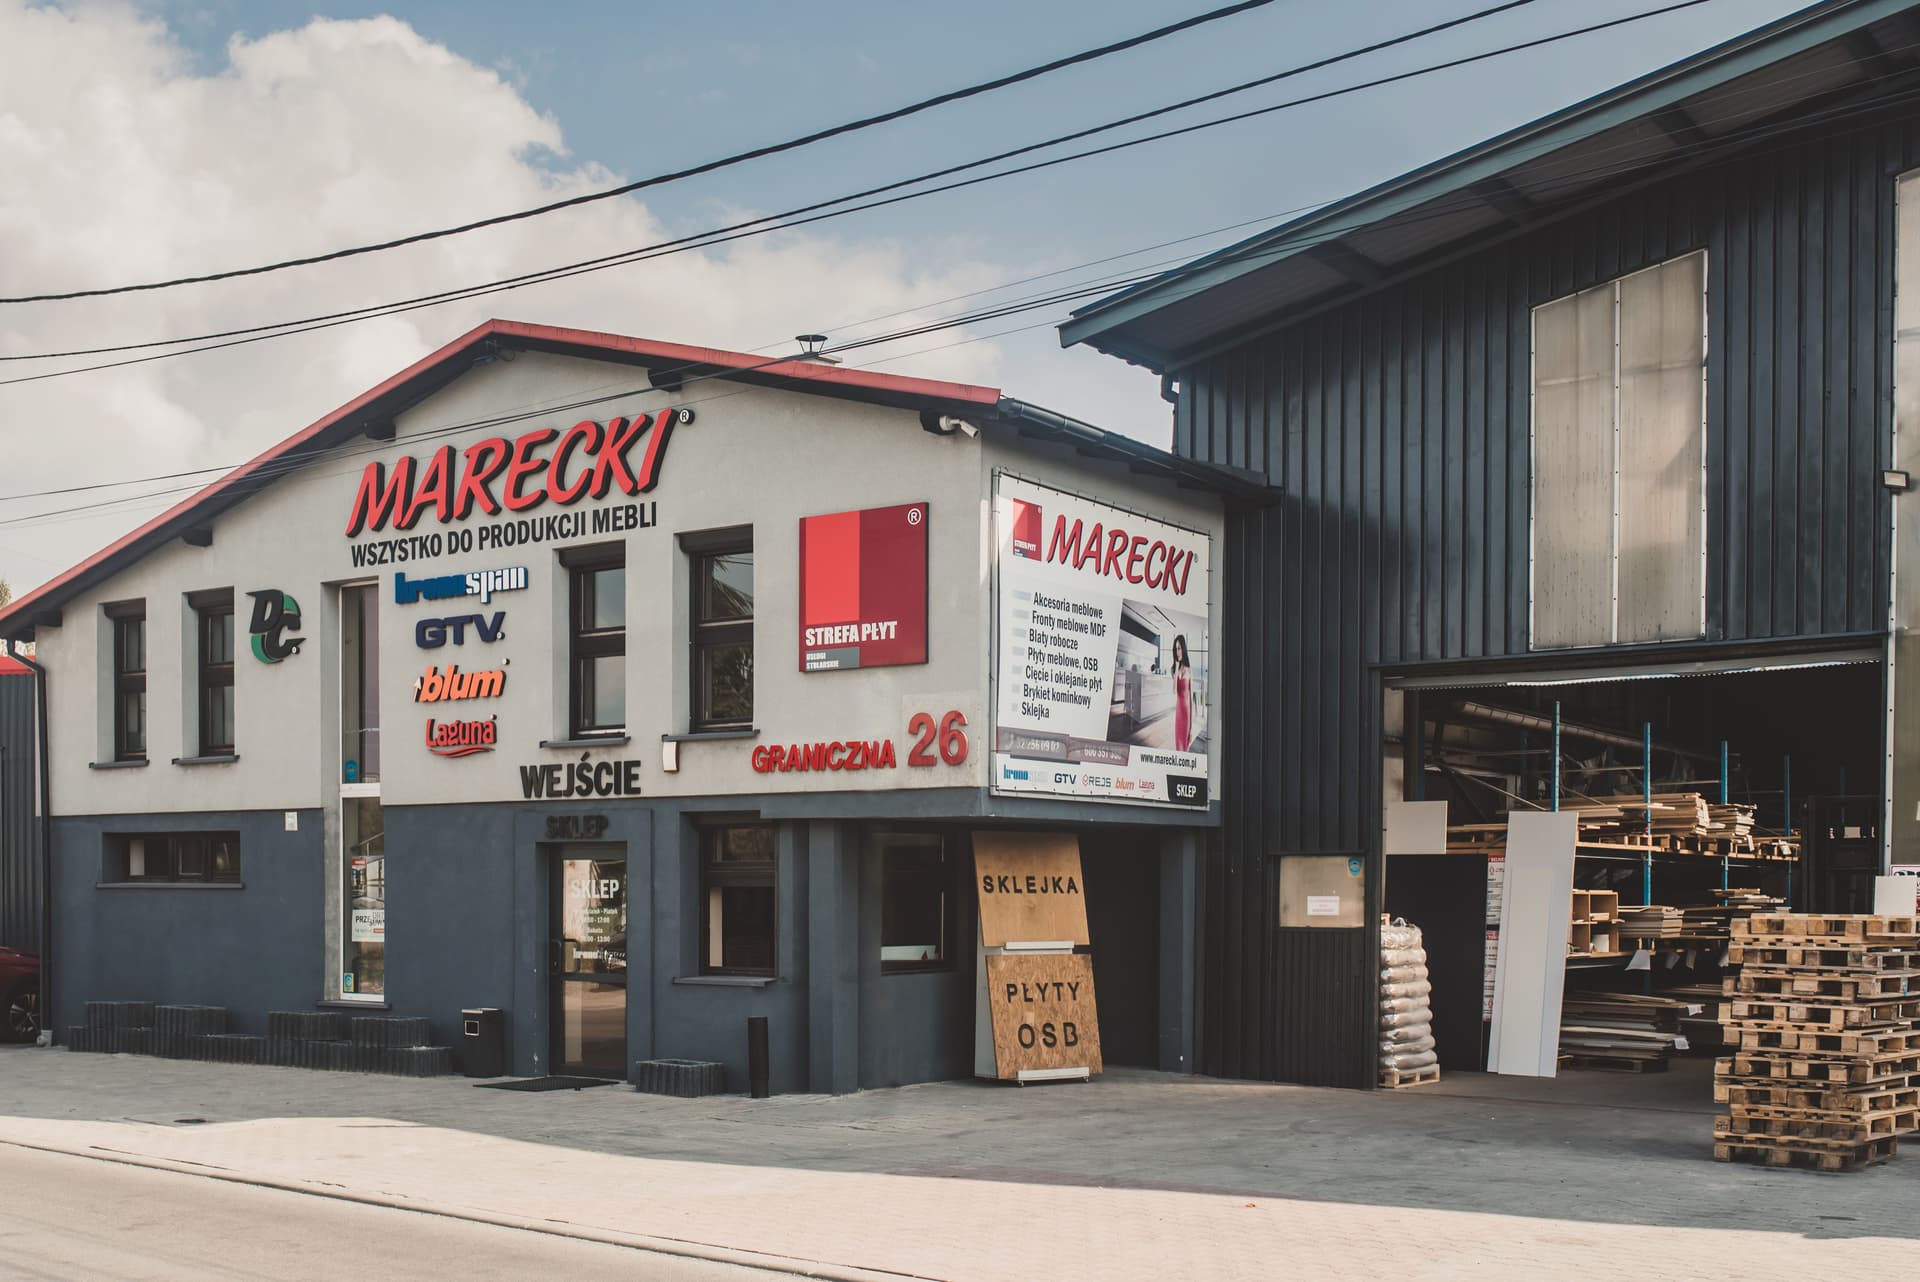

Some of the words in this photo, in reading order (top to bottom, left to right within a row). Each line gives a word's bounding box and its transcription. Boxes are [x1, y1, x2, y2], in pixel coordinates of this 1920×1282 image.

[346, 408, 678, 538] MARECKI
[351, 536, 442, 568] WSZYSTKO
[447, 529, 473, 556] DO
[478, 510, 586, 550] PRODUKCJI
[592, 502, 657, 534] MEBLI
[1047, 514, 1193, 596] MARECKI
[1033, 592, 1071, 614] Akcesoria
[1072, 603, 1103, 620] meblowe
[416, 611, 506, 649] GTV
[805, 624, 859, 646] STREFA
[861, 620, 897, 642] PŁYT
[1032, 610, 1055, 631] Fronty
[1056, 618, 1088, 634] meblowe
[1090, 622, 1106, 638] MDF
[1029, 628, 1049, 648] Blaty
[1050, 632, 1078, 650] robocze
[1027, 647, 1046, 667] Płyty
[1083, 655, 1098, 672] OSB
[420, 664, 507, 703] blum
[1025, 666, 1049, 684] Cięcie
[1050, 669, 1054, 681] i
[1055, 669, 1088, 689] oklejanie
[1089, 676, 1102, 693] płyt
[1023, 683, 1050, 702] Brykiet
[1051, 687, 1091, 707] kominkowy
[1021, 704, 1050, 720] Sklejka
[425, 719, 497, 747] Laguna
[907, 710, 969, 766] 26
[751, 739, 897, 772] GRANICZNA
[1140, 753, 1197, 770] www.marecki.com.pl
[520, 751, 641, 799] WEJŚCIE
[1054, 773, 1077, 785] GTV
[1115, 777, 1135, 790] blum
[1176, 784, 1197, 798] SKLEP
[545, 815, 609, 840] SKLEP
[571, 879, 620, 899] SKLEP
[982, 875, 1079, 895] SKLEJKA
[1006, 982, 1080, 1003] PŁYTY
[1018, 1022, 1079, 1049] OSB
